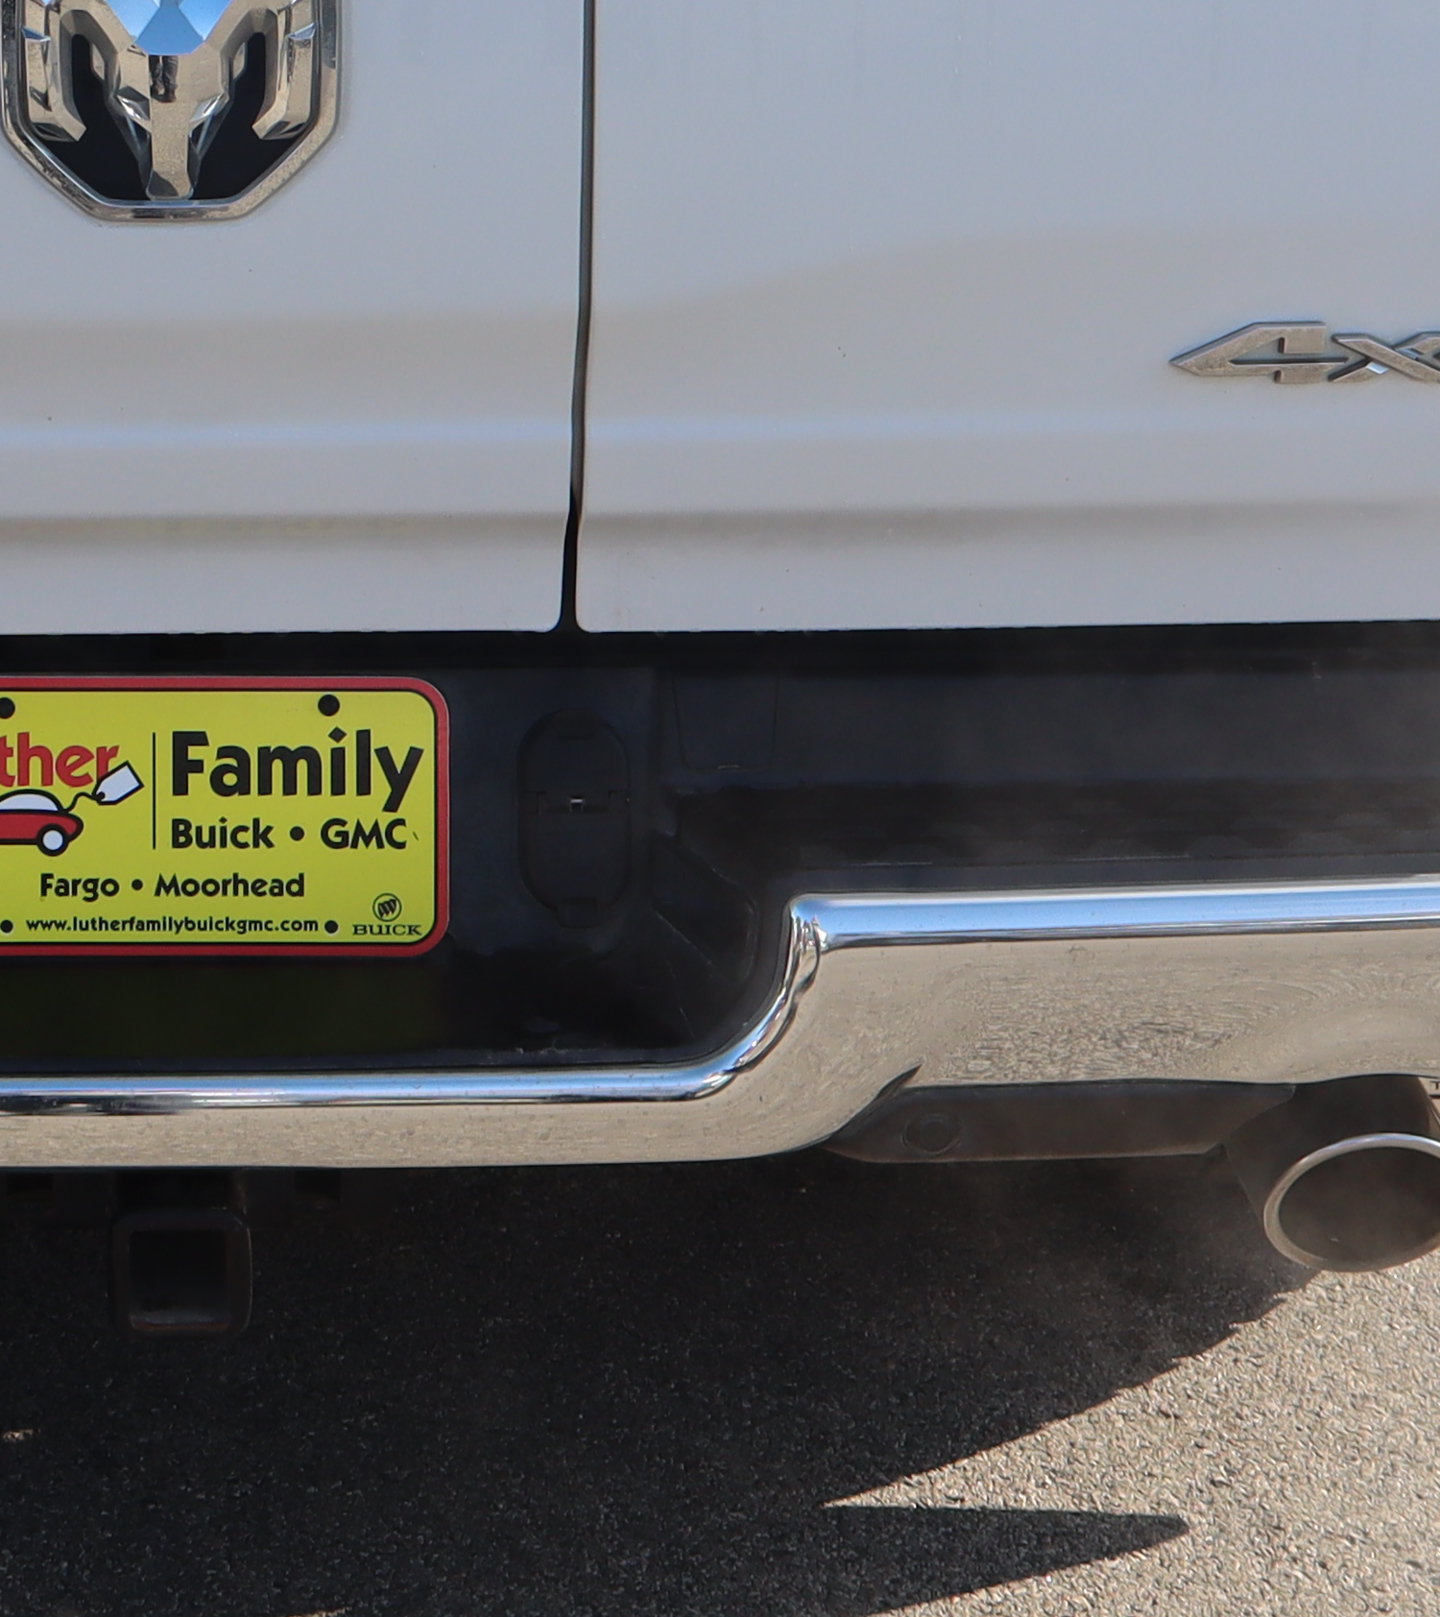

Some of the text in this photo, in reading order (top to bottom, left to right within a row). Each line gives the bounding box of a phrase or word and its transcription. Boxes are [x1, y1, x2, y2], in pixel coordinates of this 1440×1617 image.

[170, 726, 425, 814] Family
[171, 817, 408, 850] Buick GMC
[40, 872, 306, 903] Fargo Moorhead
[26, 915, 319, 935] www.lutherfamilybuickgmc.com
[351, 923, 423, 937] BUICK
